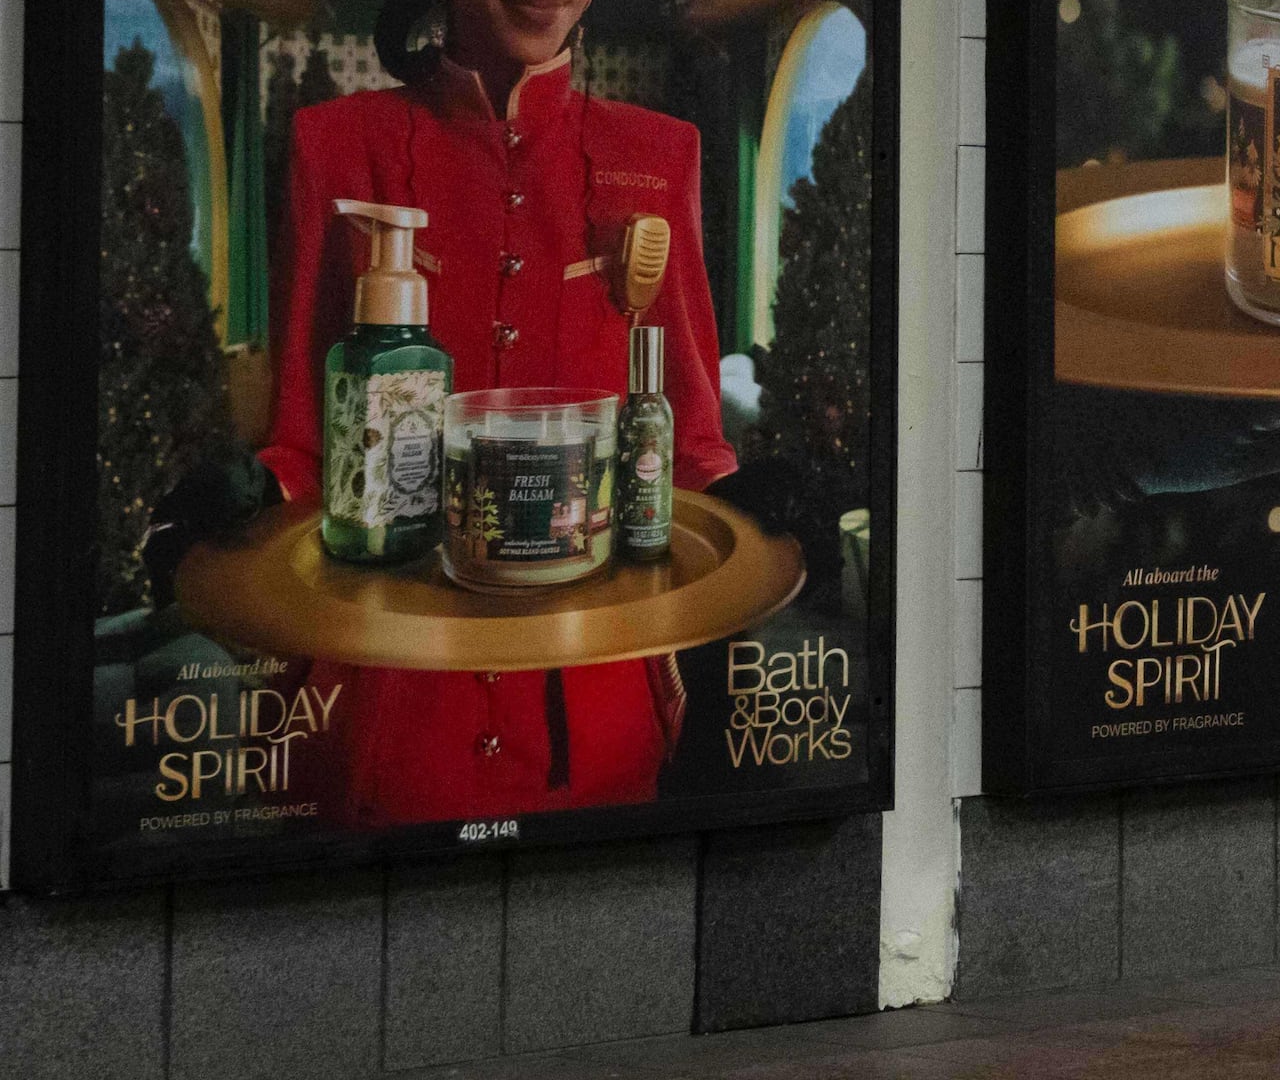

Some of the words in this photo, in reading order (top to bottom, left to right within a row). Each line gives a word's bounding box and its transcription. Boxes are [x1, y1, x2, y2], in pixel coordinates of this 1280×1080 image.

[595, 171, 668, 192] CONDUCTOR
[508, 488, 555, 502] BALSAM
[514, 474, 551, 488] FRESH
[1122, 568, 1143, 587] All
[1145, 565, 1195, 585] aboard
[1196, 564, 1219, 582] the
[1069, 592, 1266, 653] HOLIDAY
[177, 663, 200, 680] All
[202, 659, 260, 679] aboard
[263, 657, 288, 674] the
[728, 636, 849, 695] Bath
[1104, 639, 1237, 710] SPIRIT
[114, 684, 343, 747] HOLIDAY
[1091, 720, 1151, 739] POWERED
[1154, 718, 1170, 733] BY
[1173, 712, 1244, 731] FRAGRANCE
[725, 720, 852, 769] Works
[155, 731, 308, 802] SPIRIT
[140, 812, 210, 831] POWERED
[214, 810, 230, 825] BY
[234, 802, 318, 821] FRAGRANCE
[459, 820, 518, 840] 402-149
